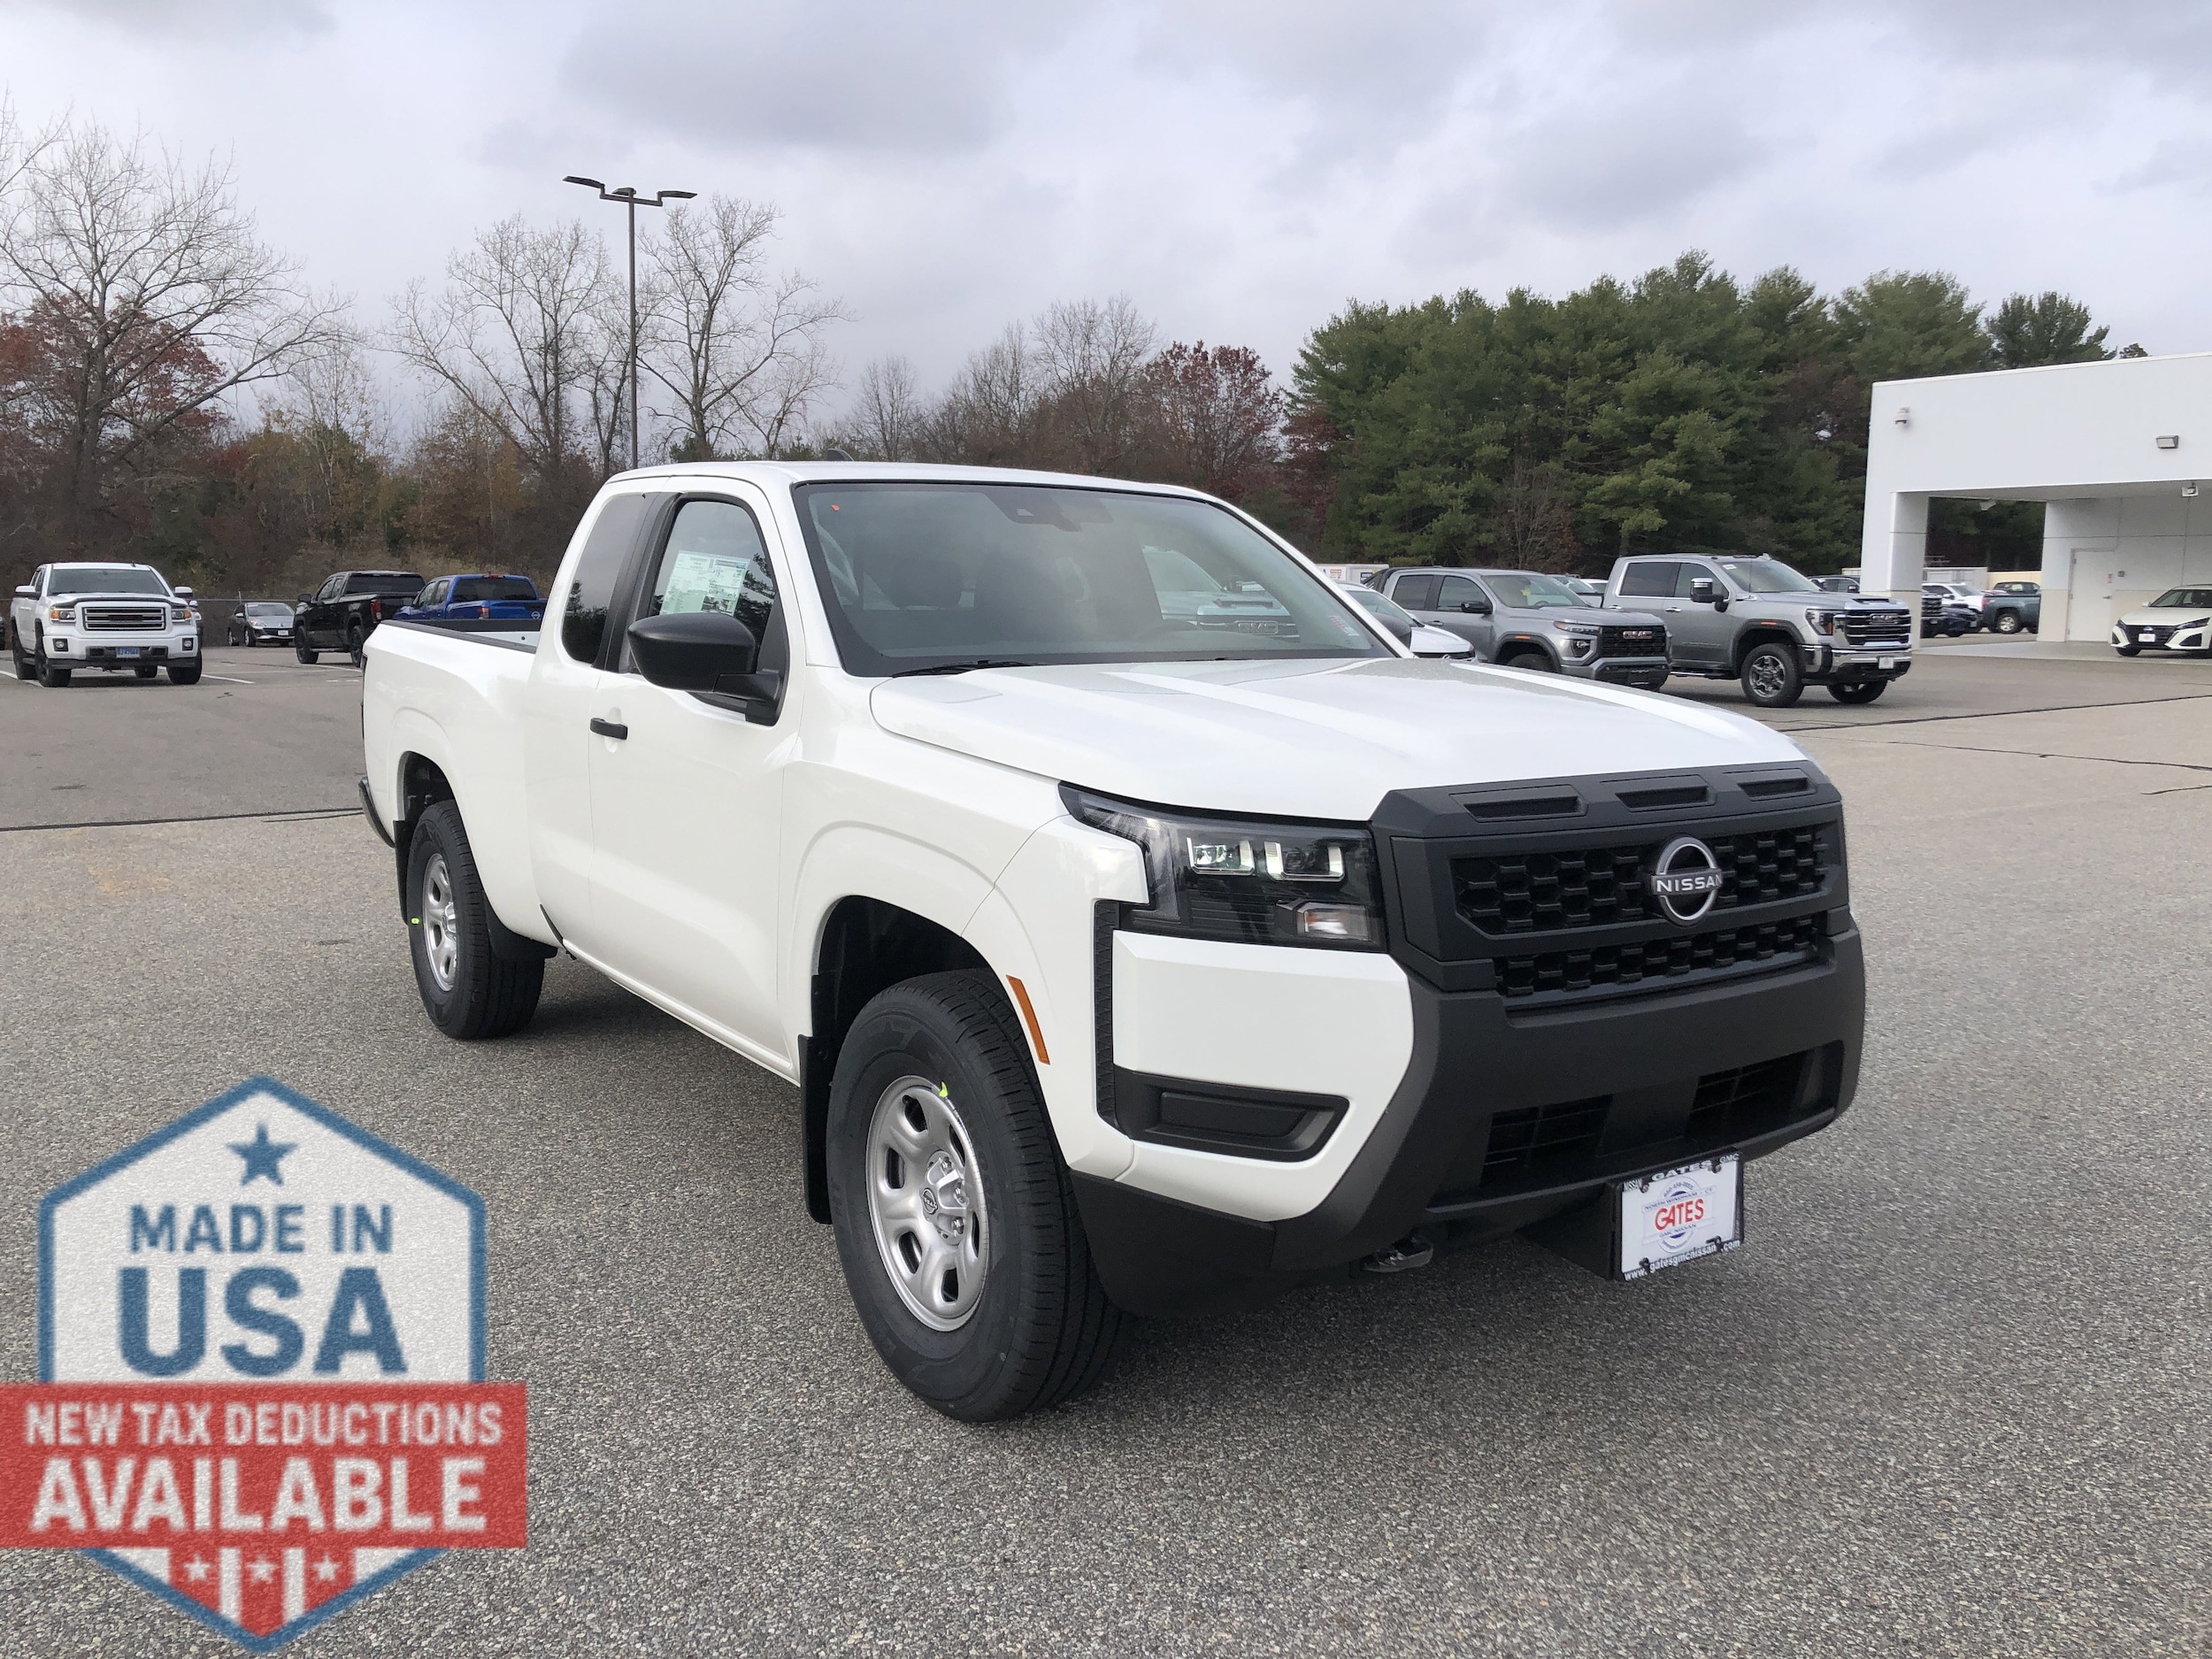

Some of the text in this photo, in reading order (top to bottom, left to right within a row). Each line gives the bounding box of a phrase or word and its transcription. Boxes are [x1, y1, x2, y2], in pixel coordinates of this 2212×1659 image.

[1656, 873, 1723, 893] NISSAN
[1651, 1160, 1712, 1181] GATES
[1719, 1153, 1740, 1164] GMC
[1655, 1198, 1704, 1231] GATES
